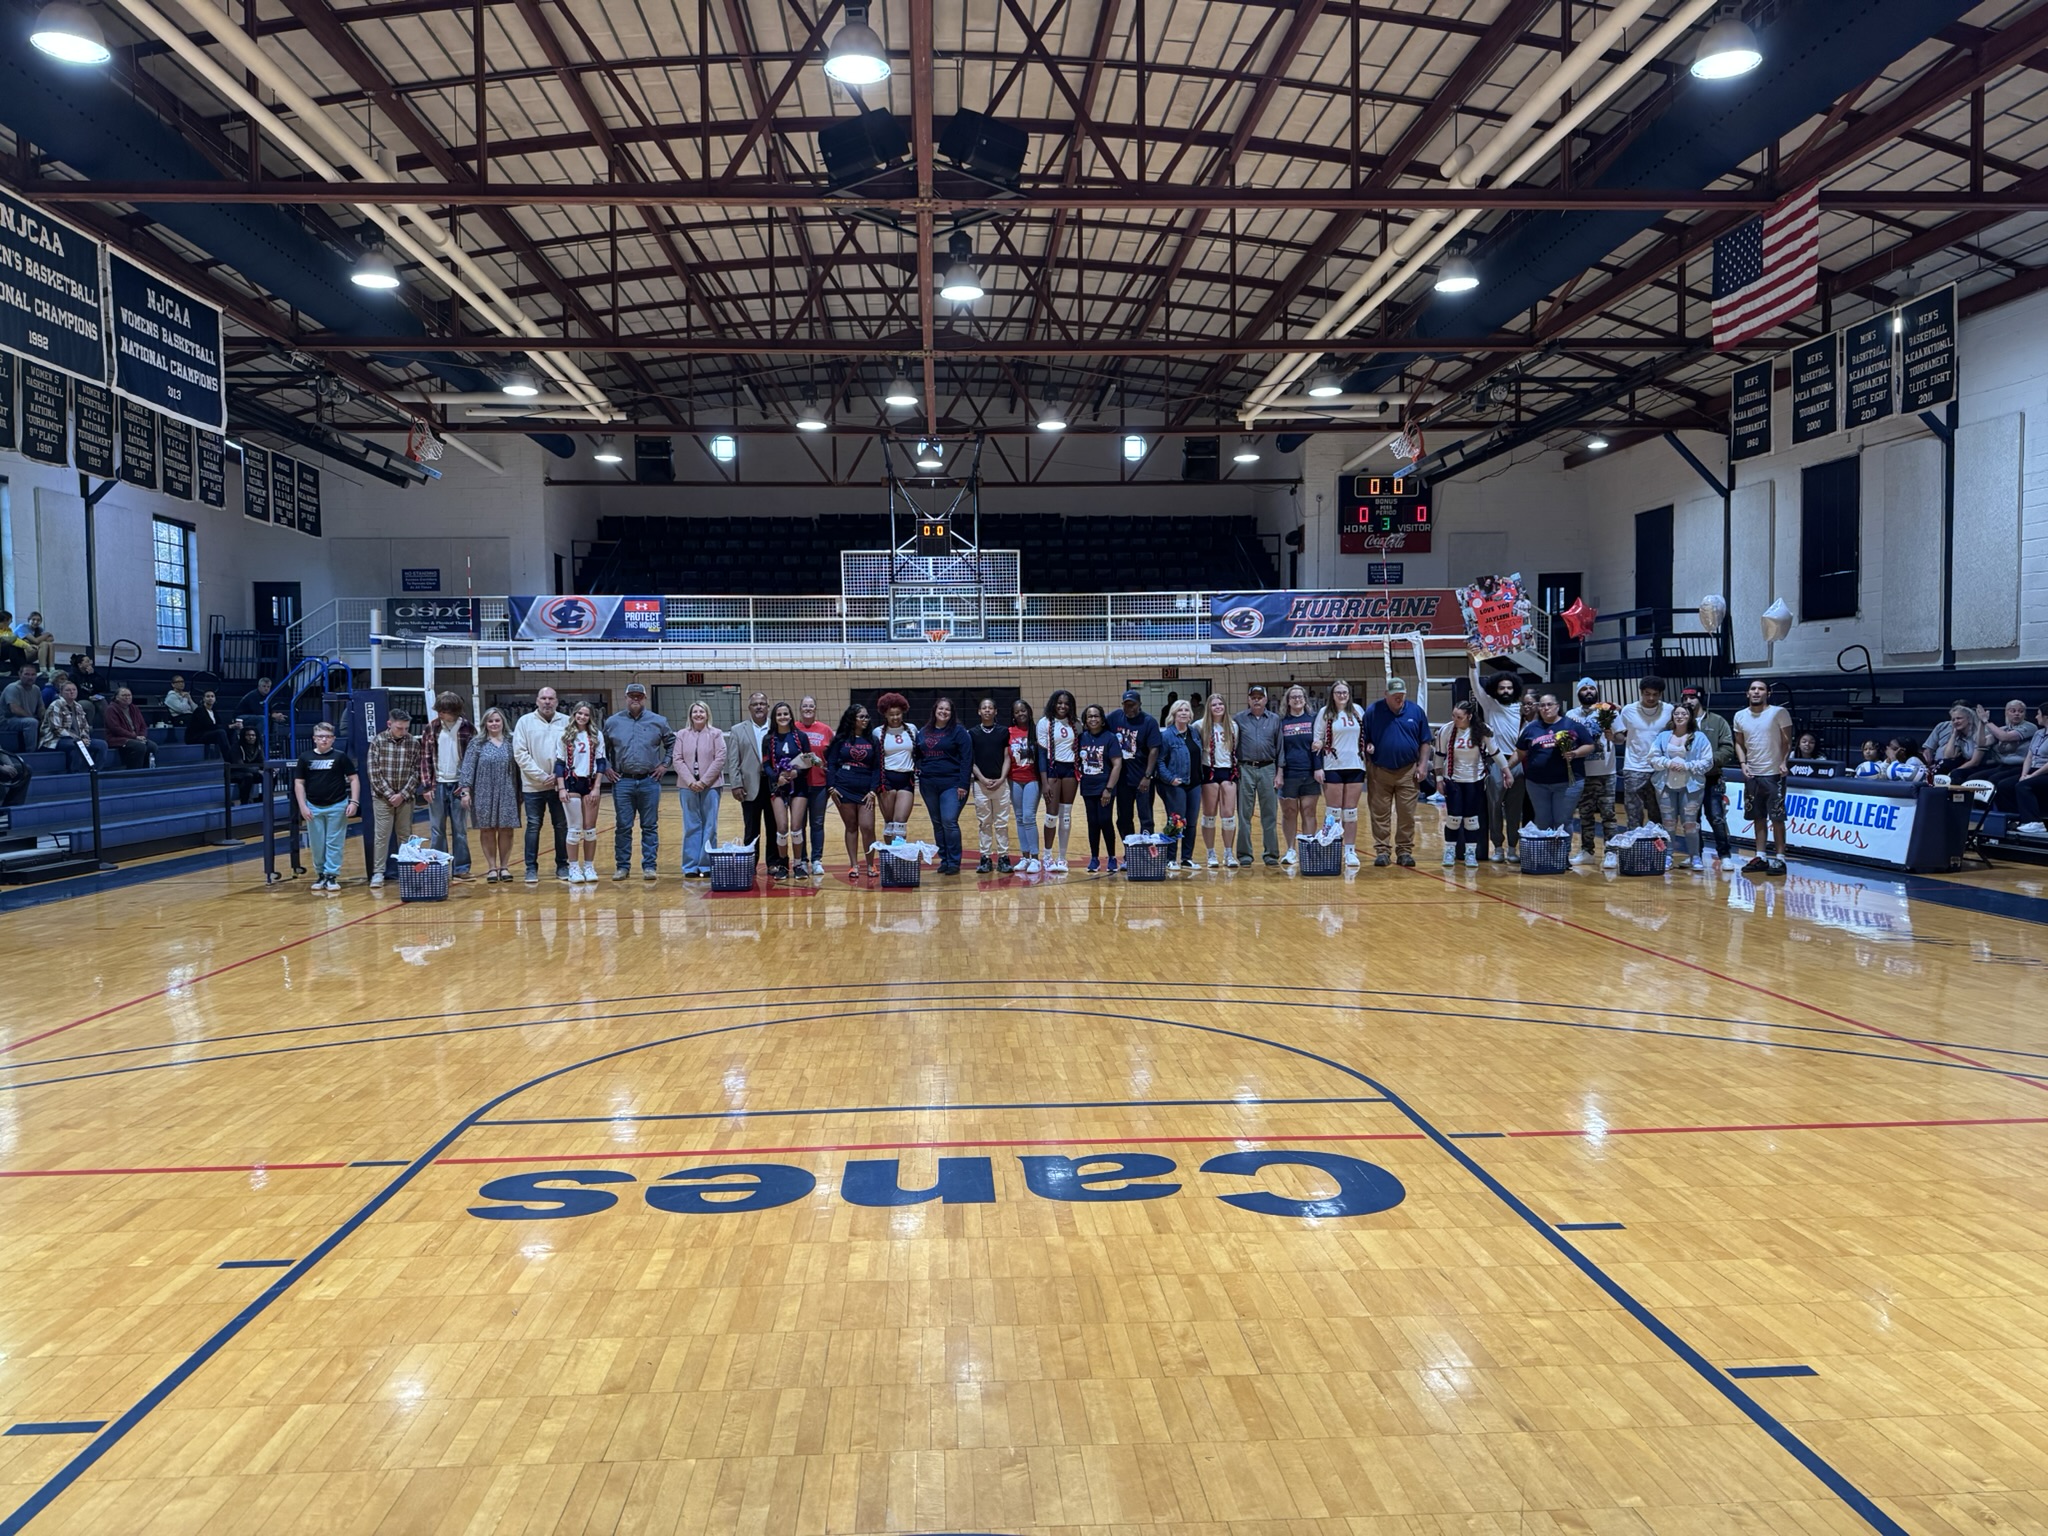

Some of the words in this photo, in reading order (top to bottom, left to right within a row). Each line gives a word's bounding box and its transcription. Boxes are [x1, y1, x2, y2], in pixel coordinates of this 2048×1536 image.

[0, 203, 65, 258] NJCAA
[25, 256, 98, 308] BASKETBALL
[146, 287, 192, 329] NJCAA
[34, 297, 98, 341] CHAMPIONS
[29, 330, 49, 350] 1992
[120, 306, 160, 339] WOMENS
[161, 327, 217, 366] BASKETBALL
[1908, 324, 1948, 347] BASKETBALL
[120, 336, 169, 371] NATIONAL
[170, 360, 219, 392] CHAMPIONS
[1852, 344, 1887, 365] BASKETBALL
[1909, 353, 1949, 378] TOURNAMENT
[25, 376, 64, 397] BASKETBALL
[1852, 373, 1889, 395] TOURNAMENT
[1909, 378, 1928, 394] ELITE
[1930, 370, 1951, 386] EIGHT
[34, 391, 55, 407] NJCAA
[167, 385, 182, 400] 2013
[1869, 389, 1888, 403] EIGHT
[30, 402, 58, 420] NATIONAL
[77, 394, 112, 415] BASKETBALL
[26, 413, 64, 434] TOURNAMENT
[81, 419, 108, 436] NATIONAL
[77, 428, 112, 448] TOURNAMENT
[1359, 506, 1369, 523] 0
[1382, 517, 1390, 530] 3
[1416, 505, 1427, 522] 0
[1343, 524, 1375, 533] HOME
[1397, 523, 1431, 532] VISITOR
[625, 611, 661, 621] PROTECT
[1287, 596, 1441, 620] HURRICANE
[1480, 606, 1495, 615] LOVE
[1497, 602, 1510, 610] YOU
[625, 621, 638, 629] THIS
[366, 703, 376, 737] PORTER
[1060, 727, 1069, 739] 9
[578, 741, 587, 754] 2
[782, 742, 790, 754] 4
[1822, 798, 1900, 831] COLLEGE
[466, 1149, 1406, 1219] Canes
